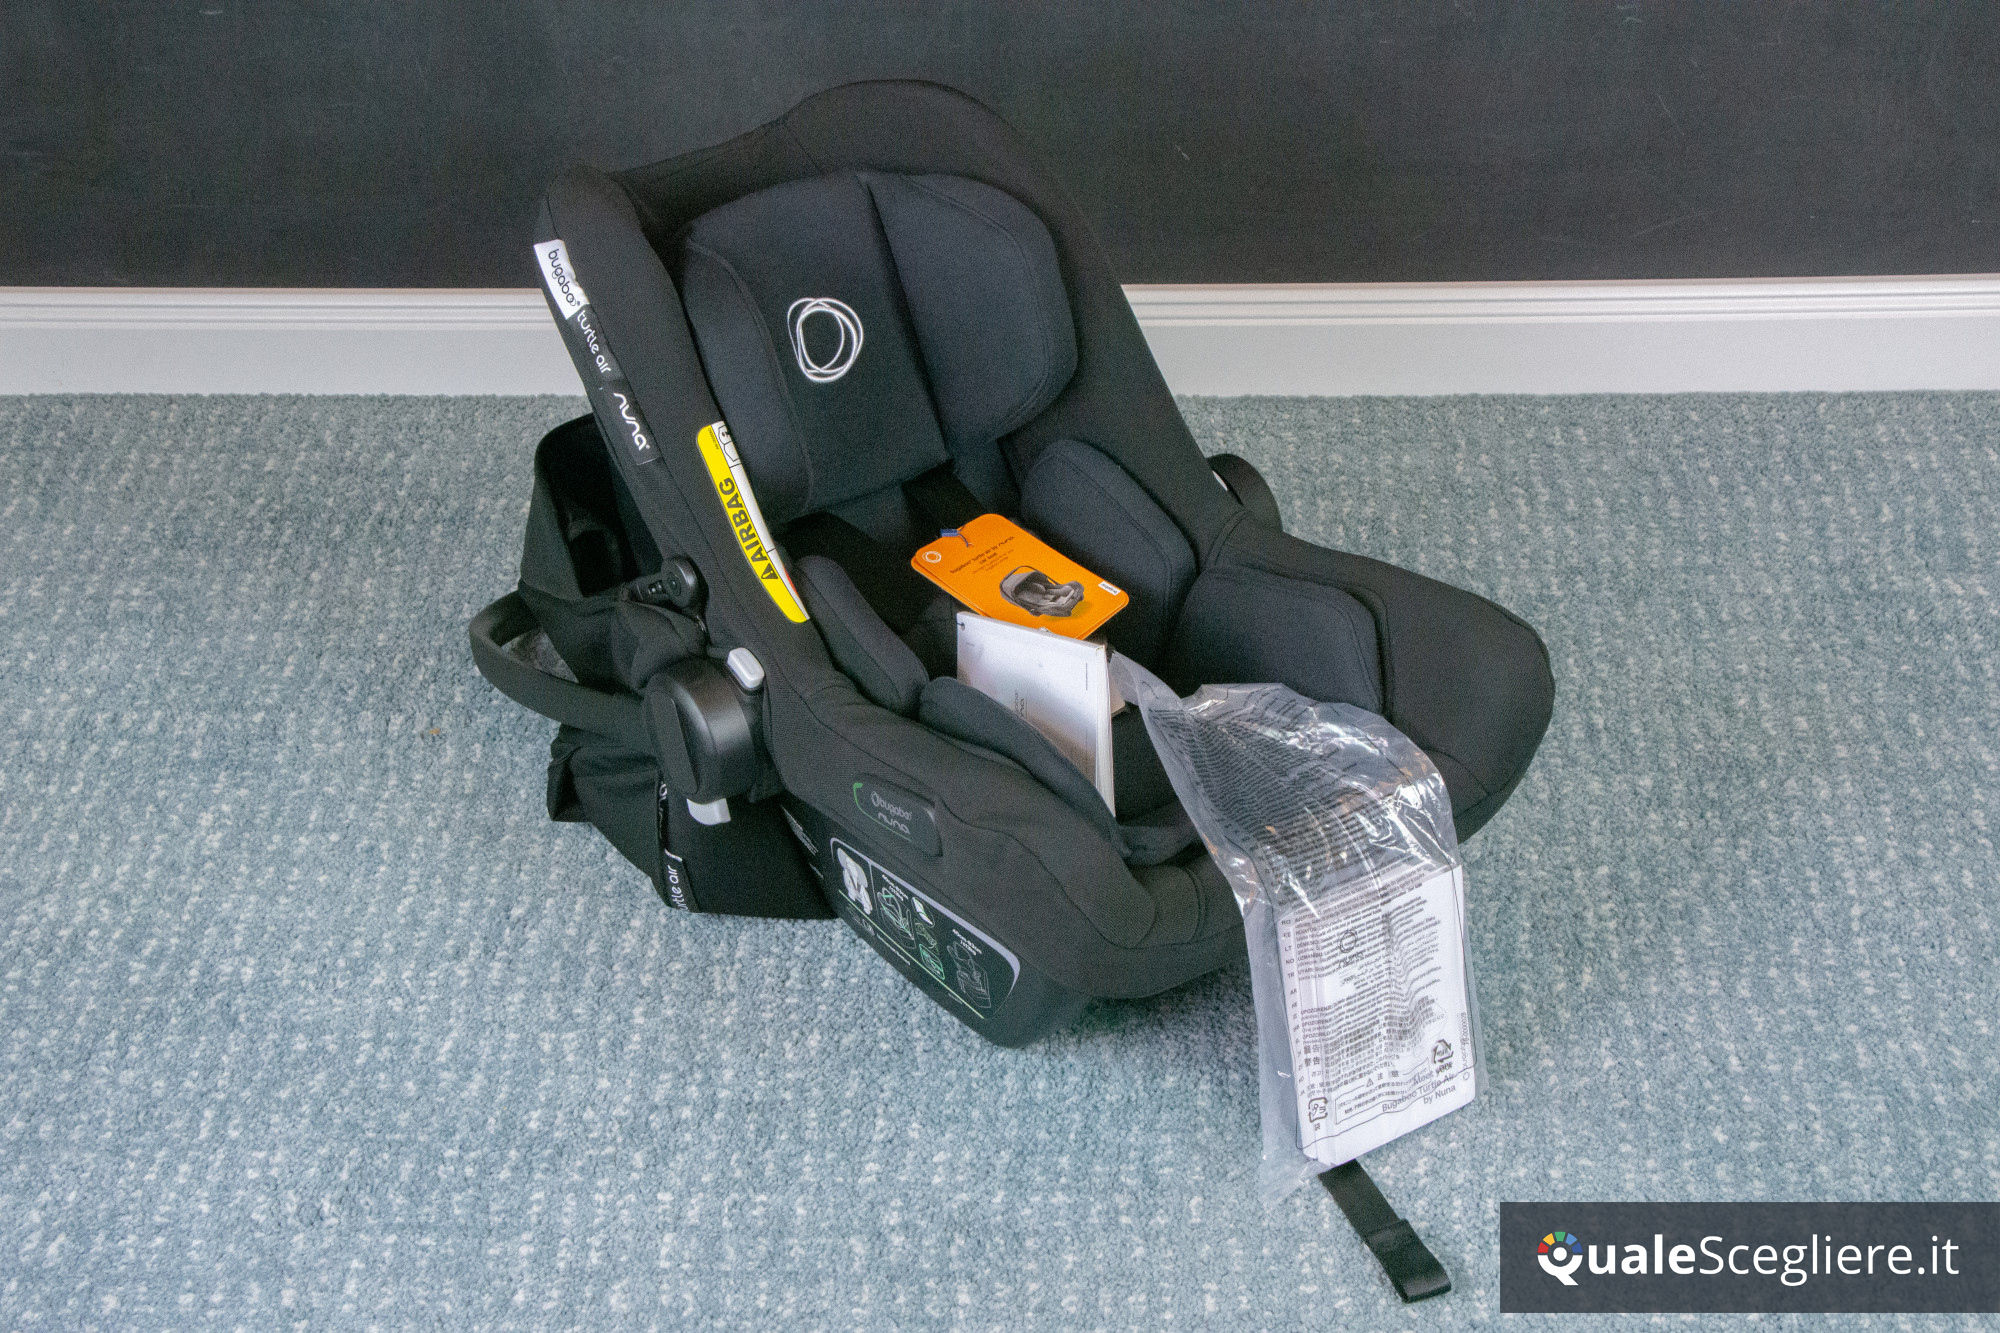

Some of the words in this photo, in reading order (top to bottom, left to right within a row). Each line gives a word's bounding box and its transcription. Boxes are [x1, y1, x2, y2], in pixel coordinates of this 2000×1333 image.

[548, 249, 577, 306] bugaboo
[577, 310, 599, 354] turtle
[596, 355, 612, 373] air
[719, 477, 768, 563] AIRBAG
[667, 865, 679, 884] air
[671, 886, 689, 911] urtle
[1423, 1096, 1433, 1104] by
[1435, 1085, 1456, 1098] Nuna
